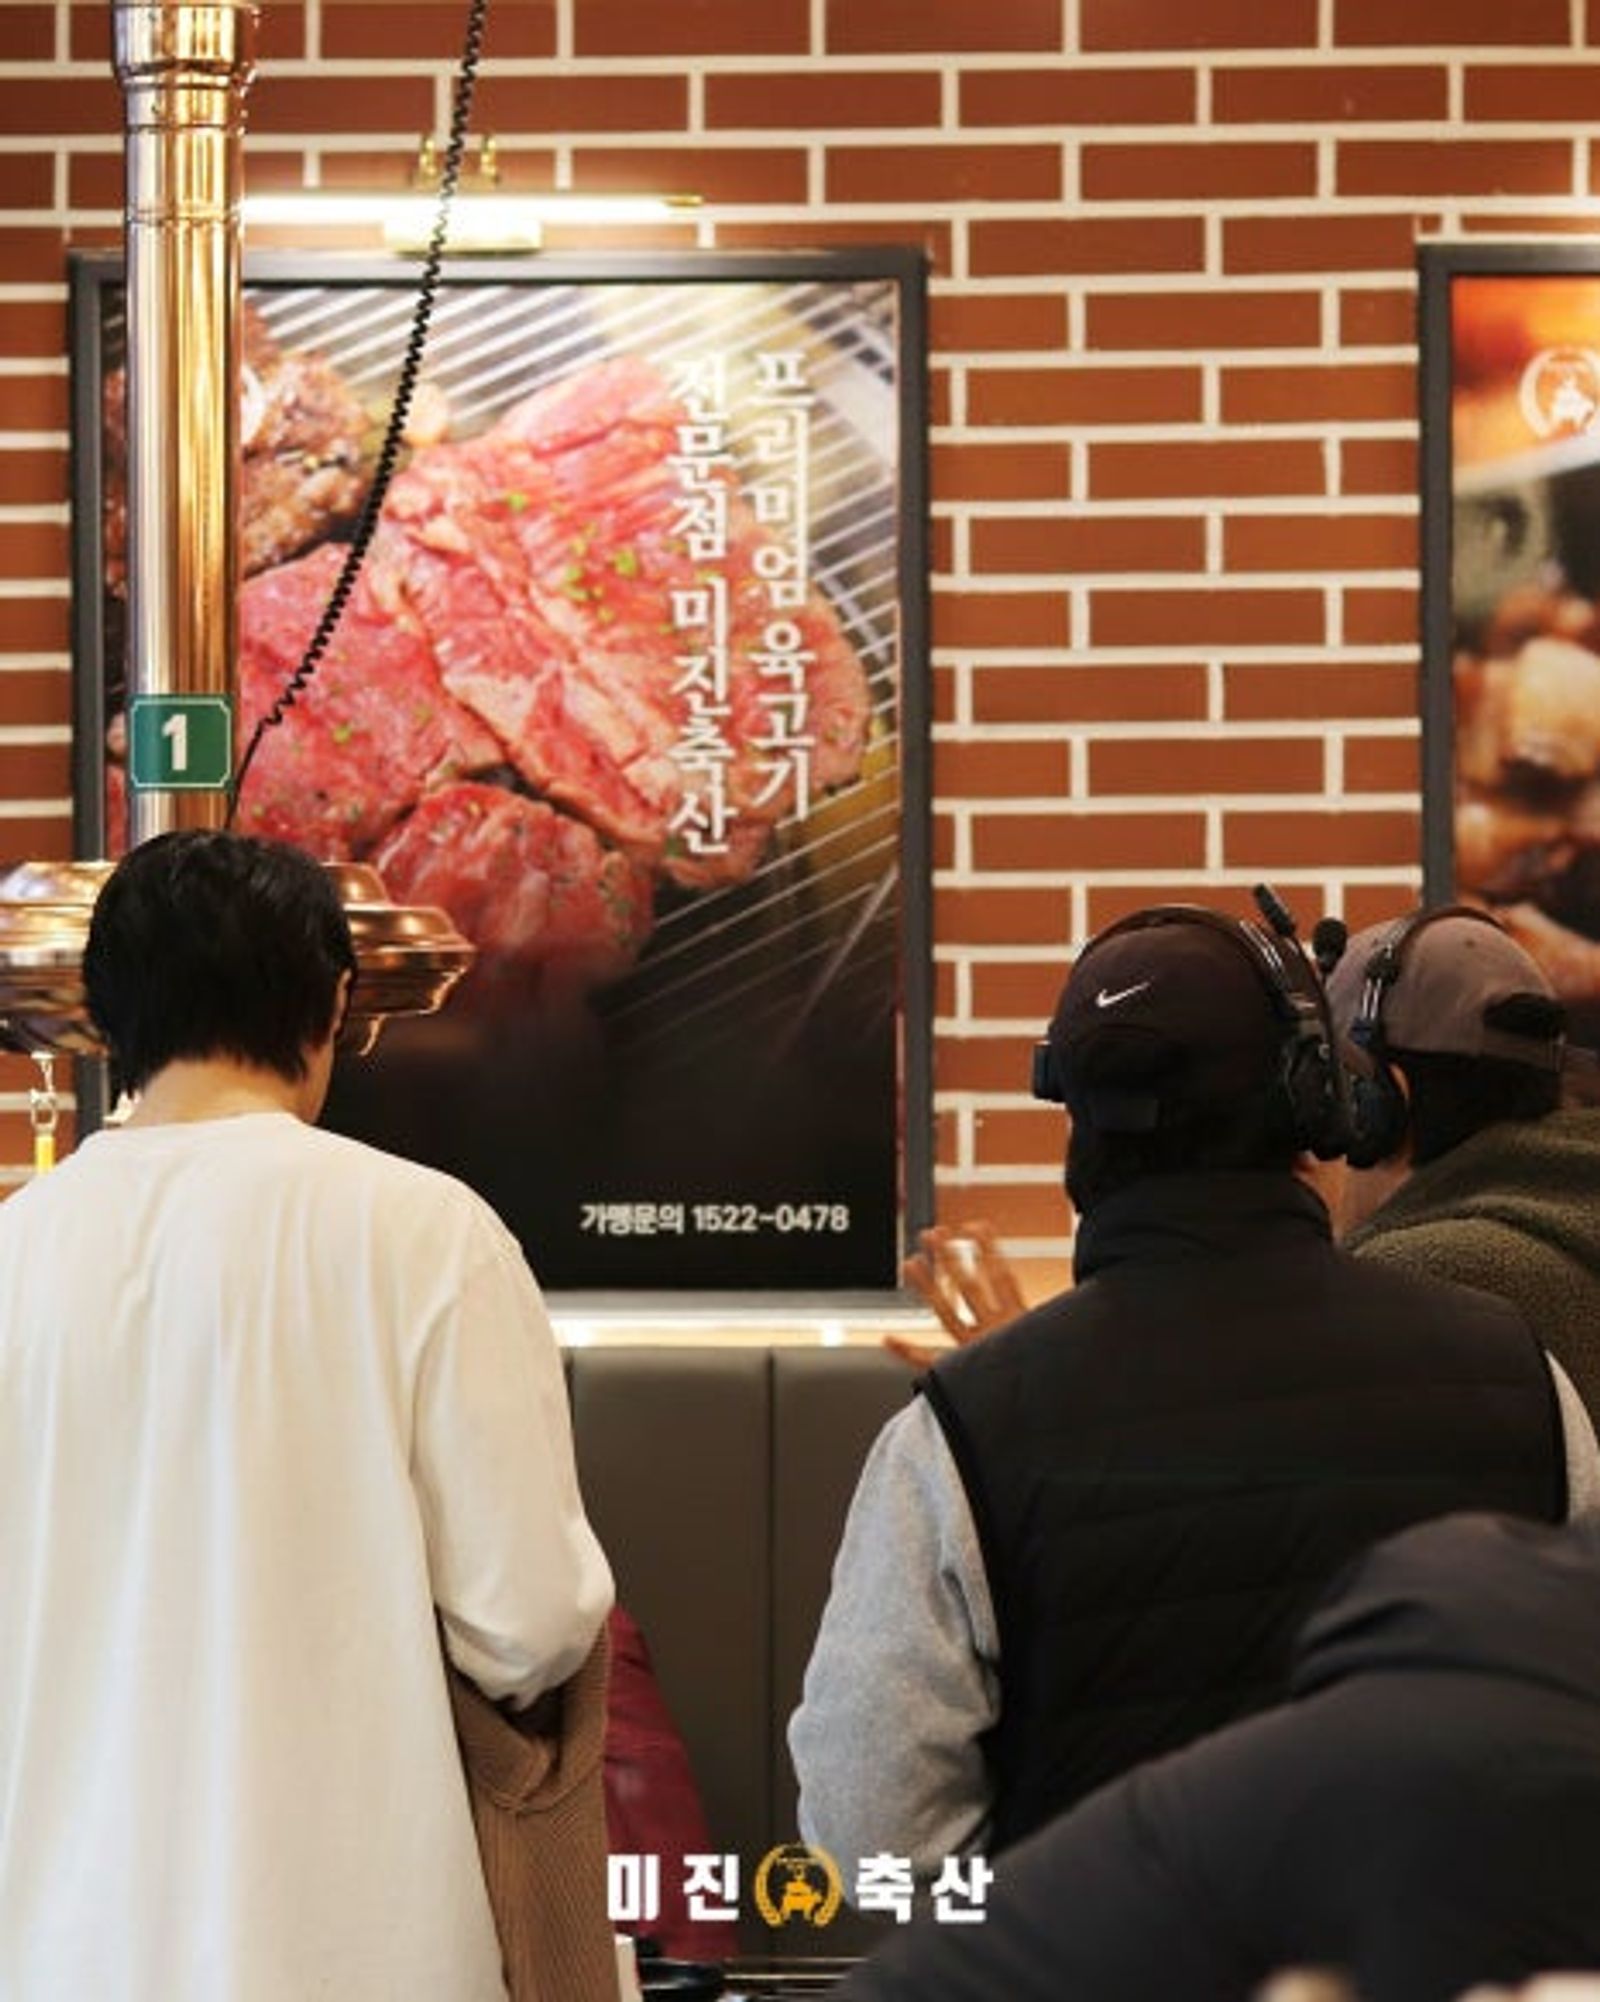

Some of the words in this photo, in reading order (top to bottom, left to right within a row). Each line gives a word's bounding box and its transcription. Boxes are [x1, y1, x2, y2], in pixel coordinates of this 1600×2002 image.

[666, 352, 735, 562] 전문점
[748, 351, 815, 606] 프리미엄
[162, 714, 187, 771] 1
[666, 577, 737, 854] 미진축산
[748, 621, 817, 820] 육고기
[580, 1204, 684, 1234] 가맹문의
[692, 1205, 849, 1231] 1522-0478
